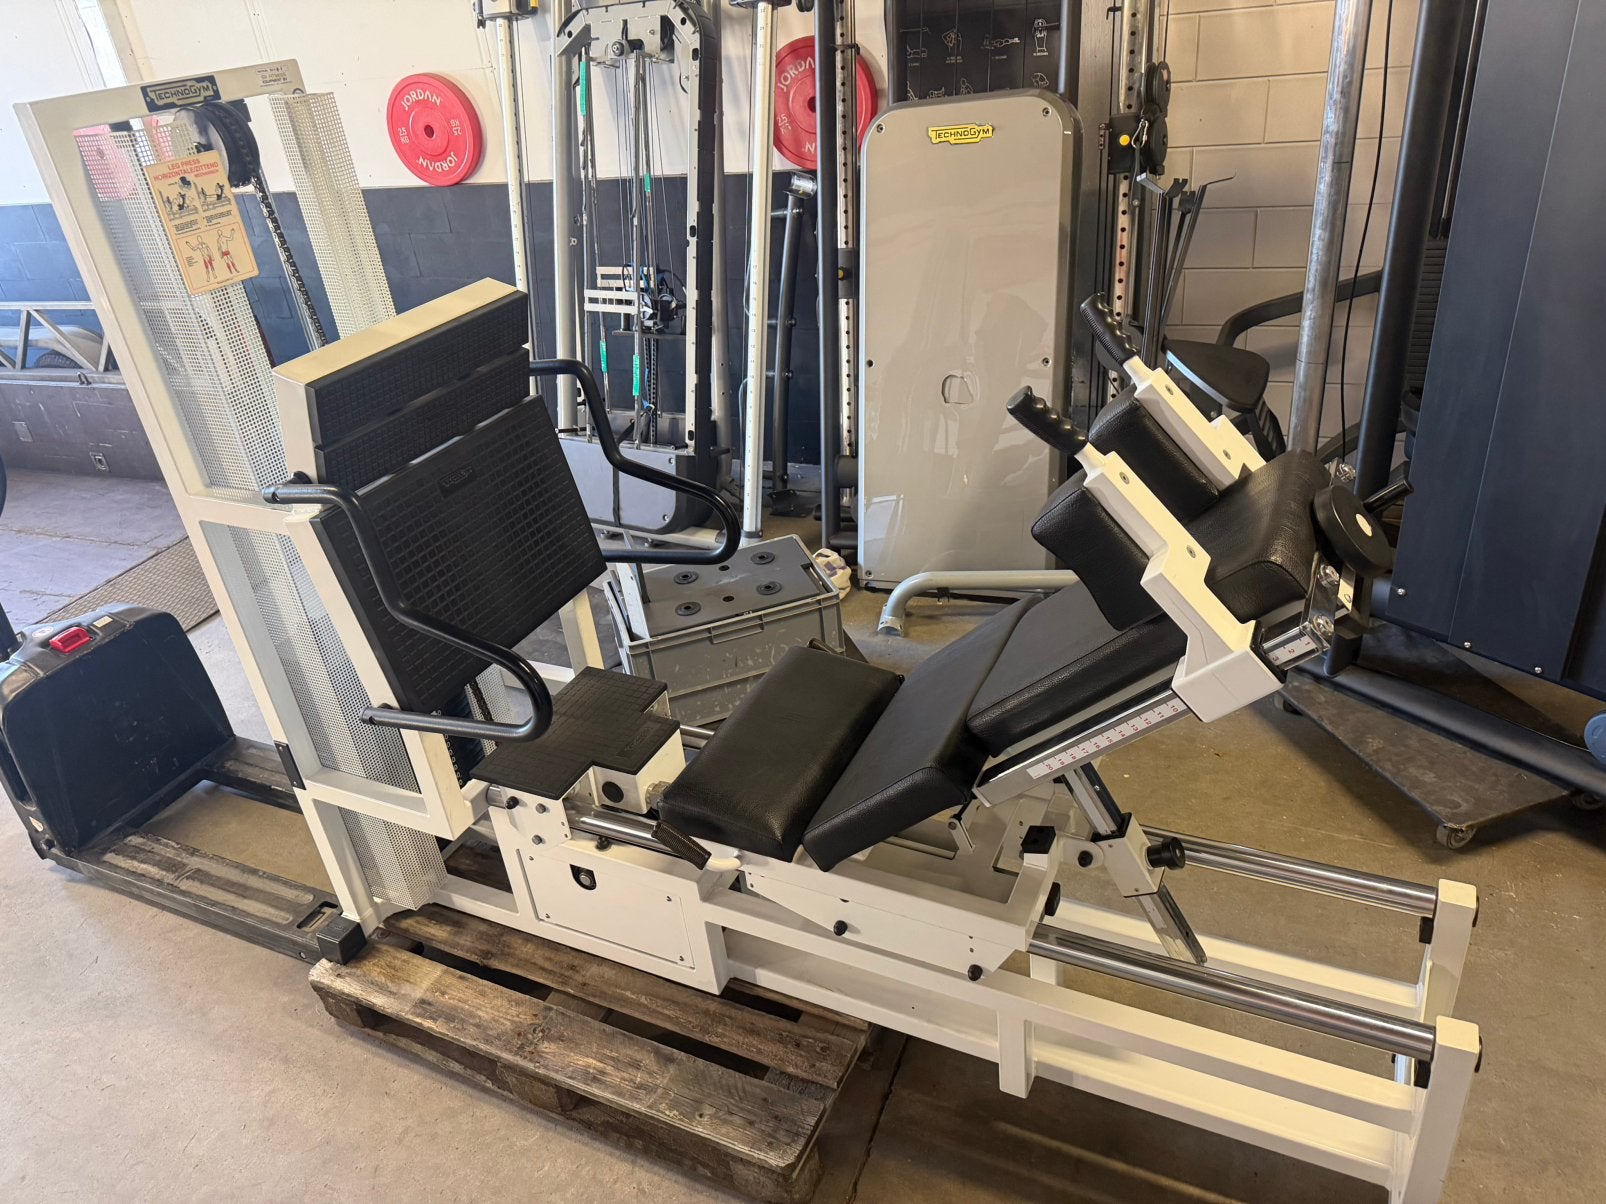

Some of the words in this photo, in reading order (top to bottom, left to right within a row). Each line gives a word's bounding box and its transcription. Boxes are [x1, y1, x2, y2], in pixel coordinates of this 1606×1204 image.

[777, 56, 815, 92] JORDA
[401, 89, 441, 111] JORDAN
[450, 119, 460, 127] KG
[451, 126, 461, 136] 25
[400, 135, 410, 144] KG
[168, 163, 180, 171] LEG
[180, 158, 201, 168] PRESS
[417, 152, 458, 173] JORDAN
[1170, 704, 1179, 713] 10
[1156, 711, 1165, 719] 11
[1143, 717, 1152, 726] 12
[1130, 723, 1139, 732] 13
[1118, 730, 1126, 738] 14
[1105, 736, 1114, 744] 15
[1093, 742, 1101, 750] 16
[1081, 747, 1089, 755] 17
[1045, 763, 1054, 771] 20
